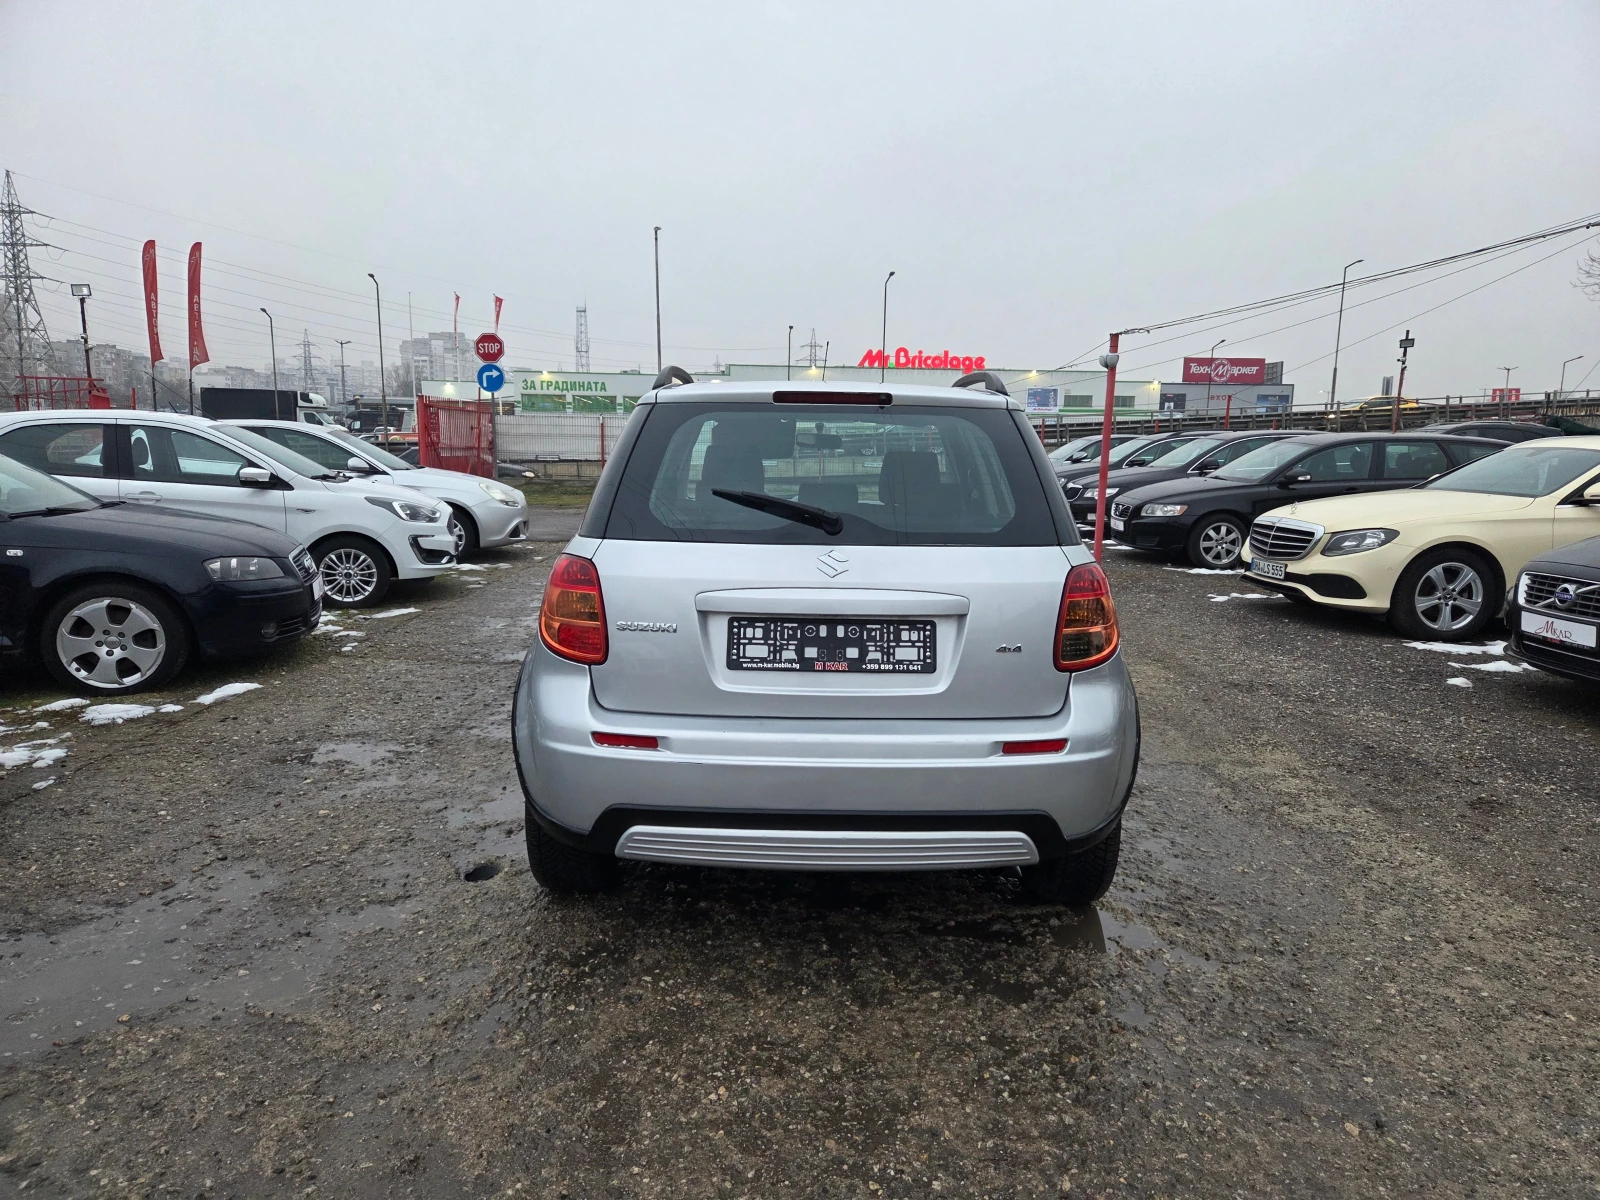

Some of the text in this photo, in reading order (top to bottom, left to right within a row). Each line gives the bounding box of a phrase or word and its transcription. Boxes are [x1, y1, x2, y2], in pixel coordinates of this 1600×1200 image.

[478, 343, 501, 354] STOP
[521, 379, 607, 393] ЗА ГРАДИНАТА
[1271, 564, 1283, 577] 555
[616, 621, 678, 633] SUZUKI
[742, 662, 800, 670] www.m-kar.mobile.bg
[814, 661, 849, 671] M KAR
